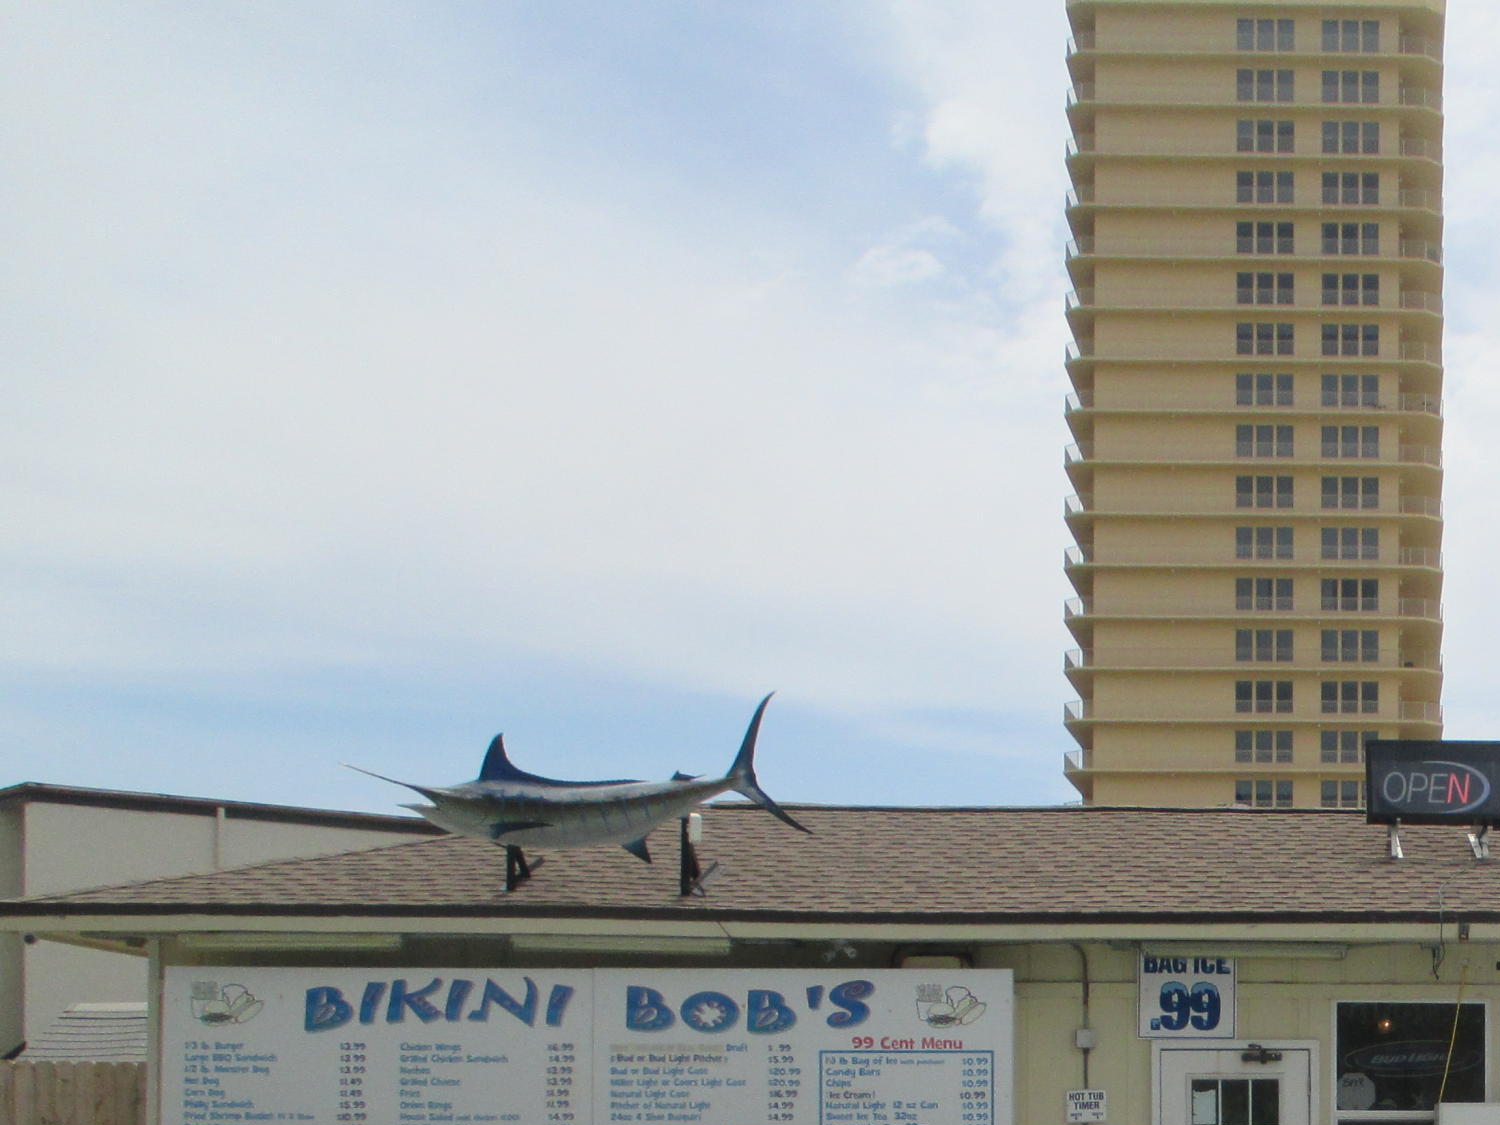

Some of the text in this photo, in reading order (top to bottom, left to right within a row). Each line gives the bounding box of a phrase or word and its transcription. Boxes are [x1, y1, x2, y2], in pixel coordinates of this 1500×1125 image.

[1384, 772, 1470, 803] OPEN
[1144, 957, 1231, 974] BAG ICE
[304, 976, 876, 1034] BIKINI BOB'S
[1150, 981, 1221, 1030] .99
[852, 1036, 963, 1050] 99 Cent Menu
[1068, 1091, 1104, 1101] HOT TUB
[1074, 1101, 1100, 1110] TIMER
